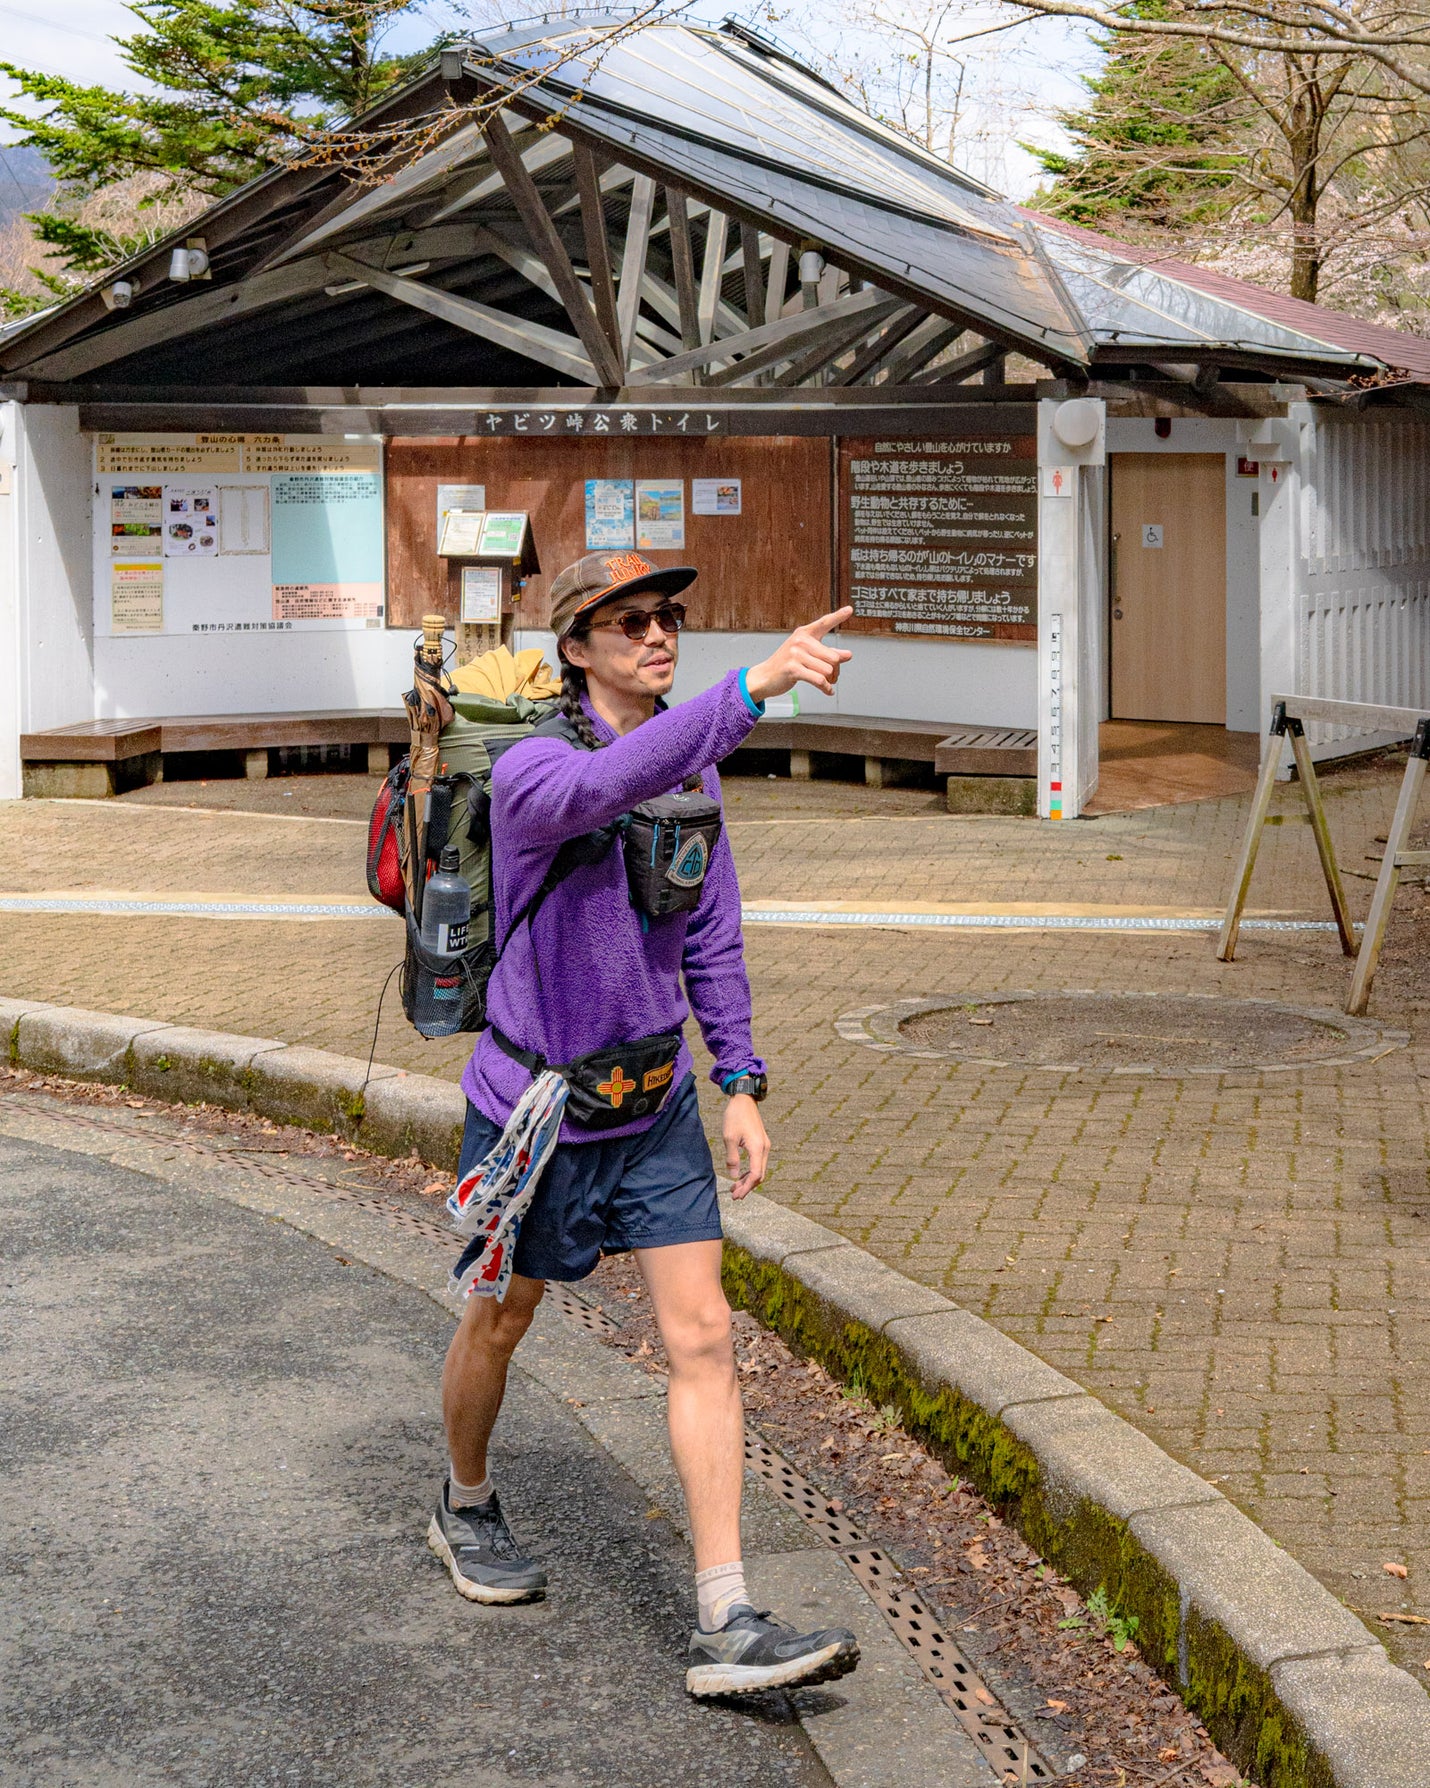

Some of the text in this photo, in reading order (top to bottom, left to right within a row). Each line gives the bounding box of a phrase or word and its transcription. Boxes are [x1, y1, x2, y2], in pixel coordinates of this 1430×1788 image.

[486, 412, 720, 432] ヤビツ峠公衆トイレ
[851, 460, 965, 474] 階段や木道を歩きましょう
[851, 586, 1011, 605] ゴミはすべて家まで持ち帰りましょう
[192, 621, 293, 632] 秦野市丹沢遭難対策協議会
[894, 622, 991, 636] 神奈川県自然環境保全センター
